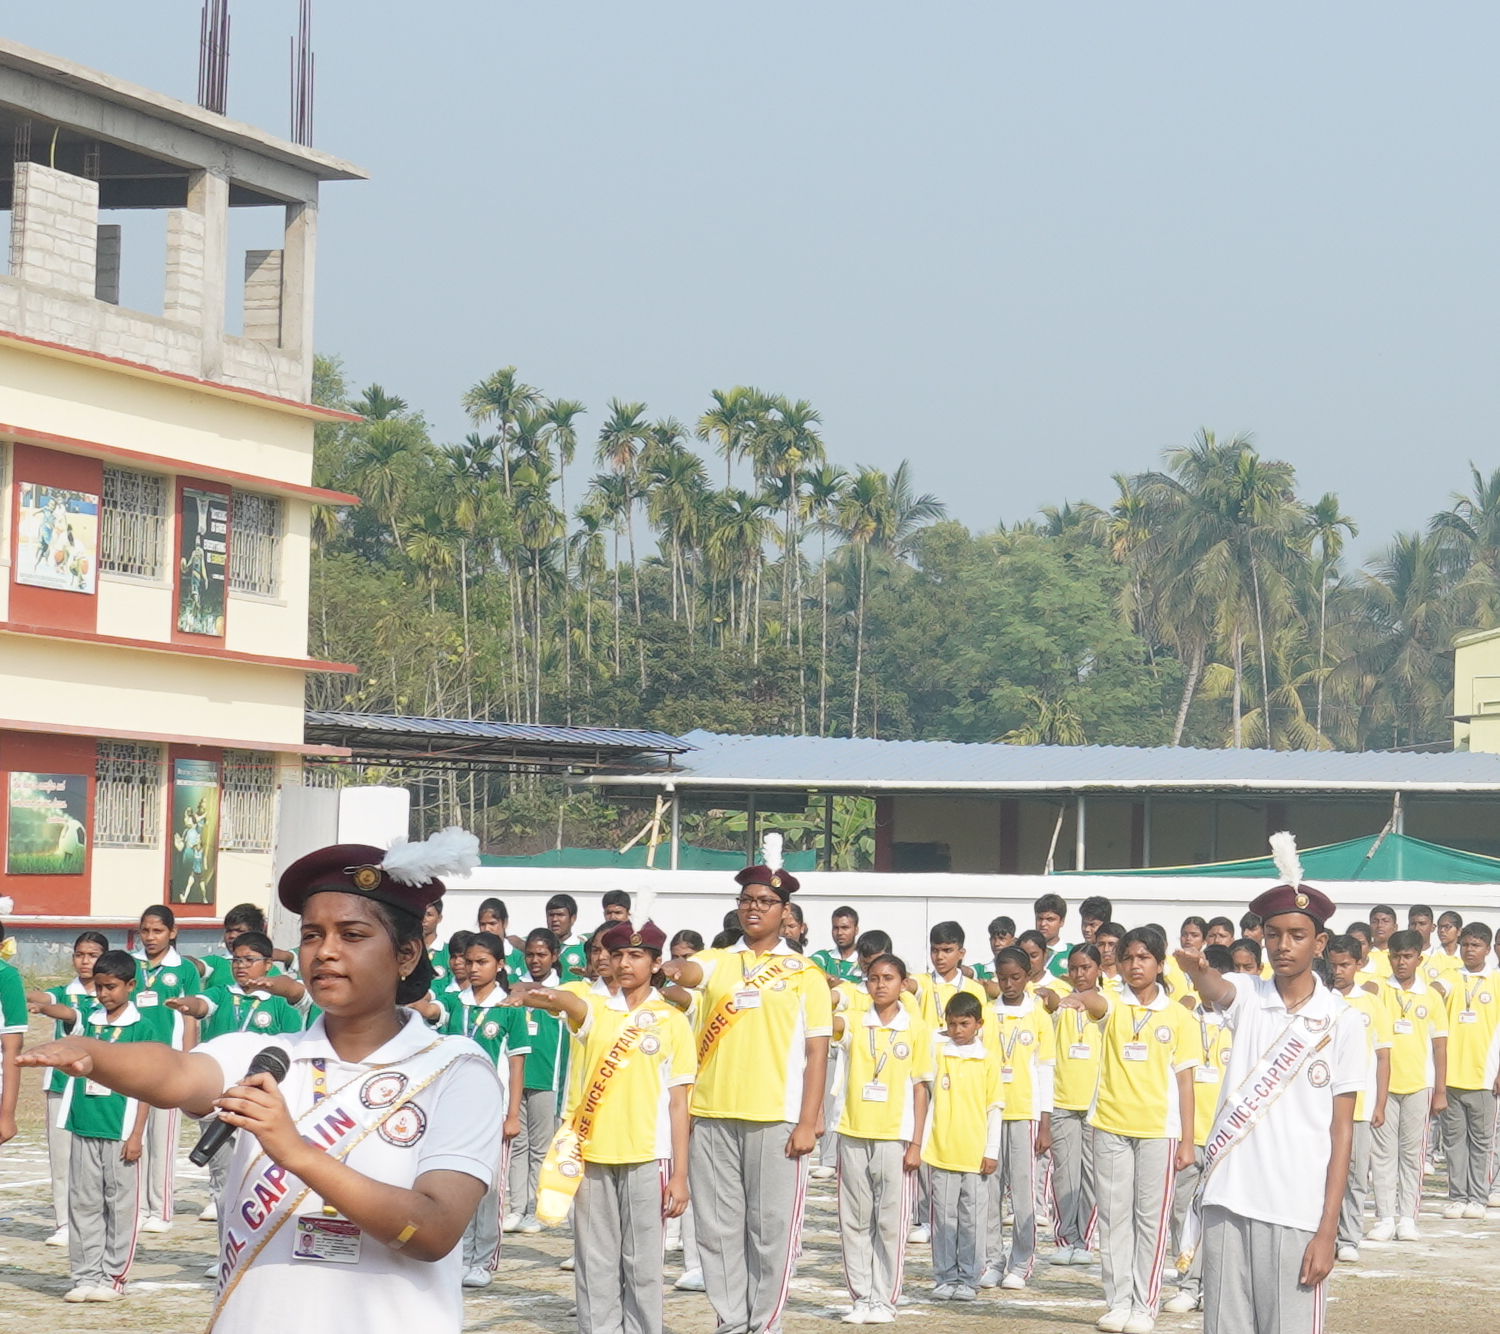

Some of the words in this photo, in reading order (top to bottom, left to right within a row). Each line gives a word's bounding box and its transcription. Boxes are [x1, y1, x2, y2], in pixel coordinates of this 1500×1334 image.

[725, 964, 783, 1015] CTAIN
[568, 1115, 592, 1163] HOUSE
[585, 1025, 640, 1113] VICE-CAPTAIN
[1227, 1037, 1305, 1130] VICE-CAPTAIN
